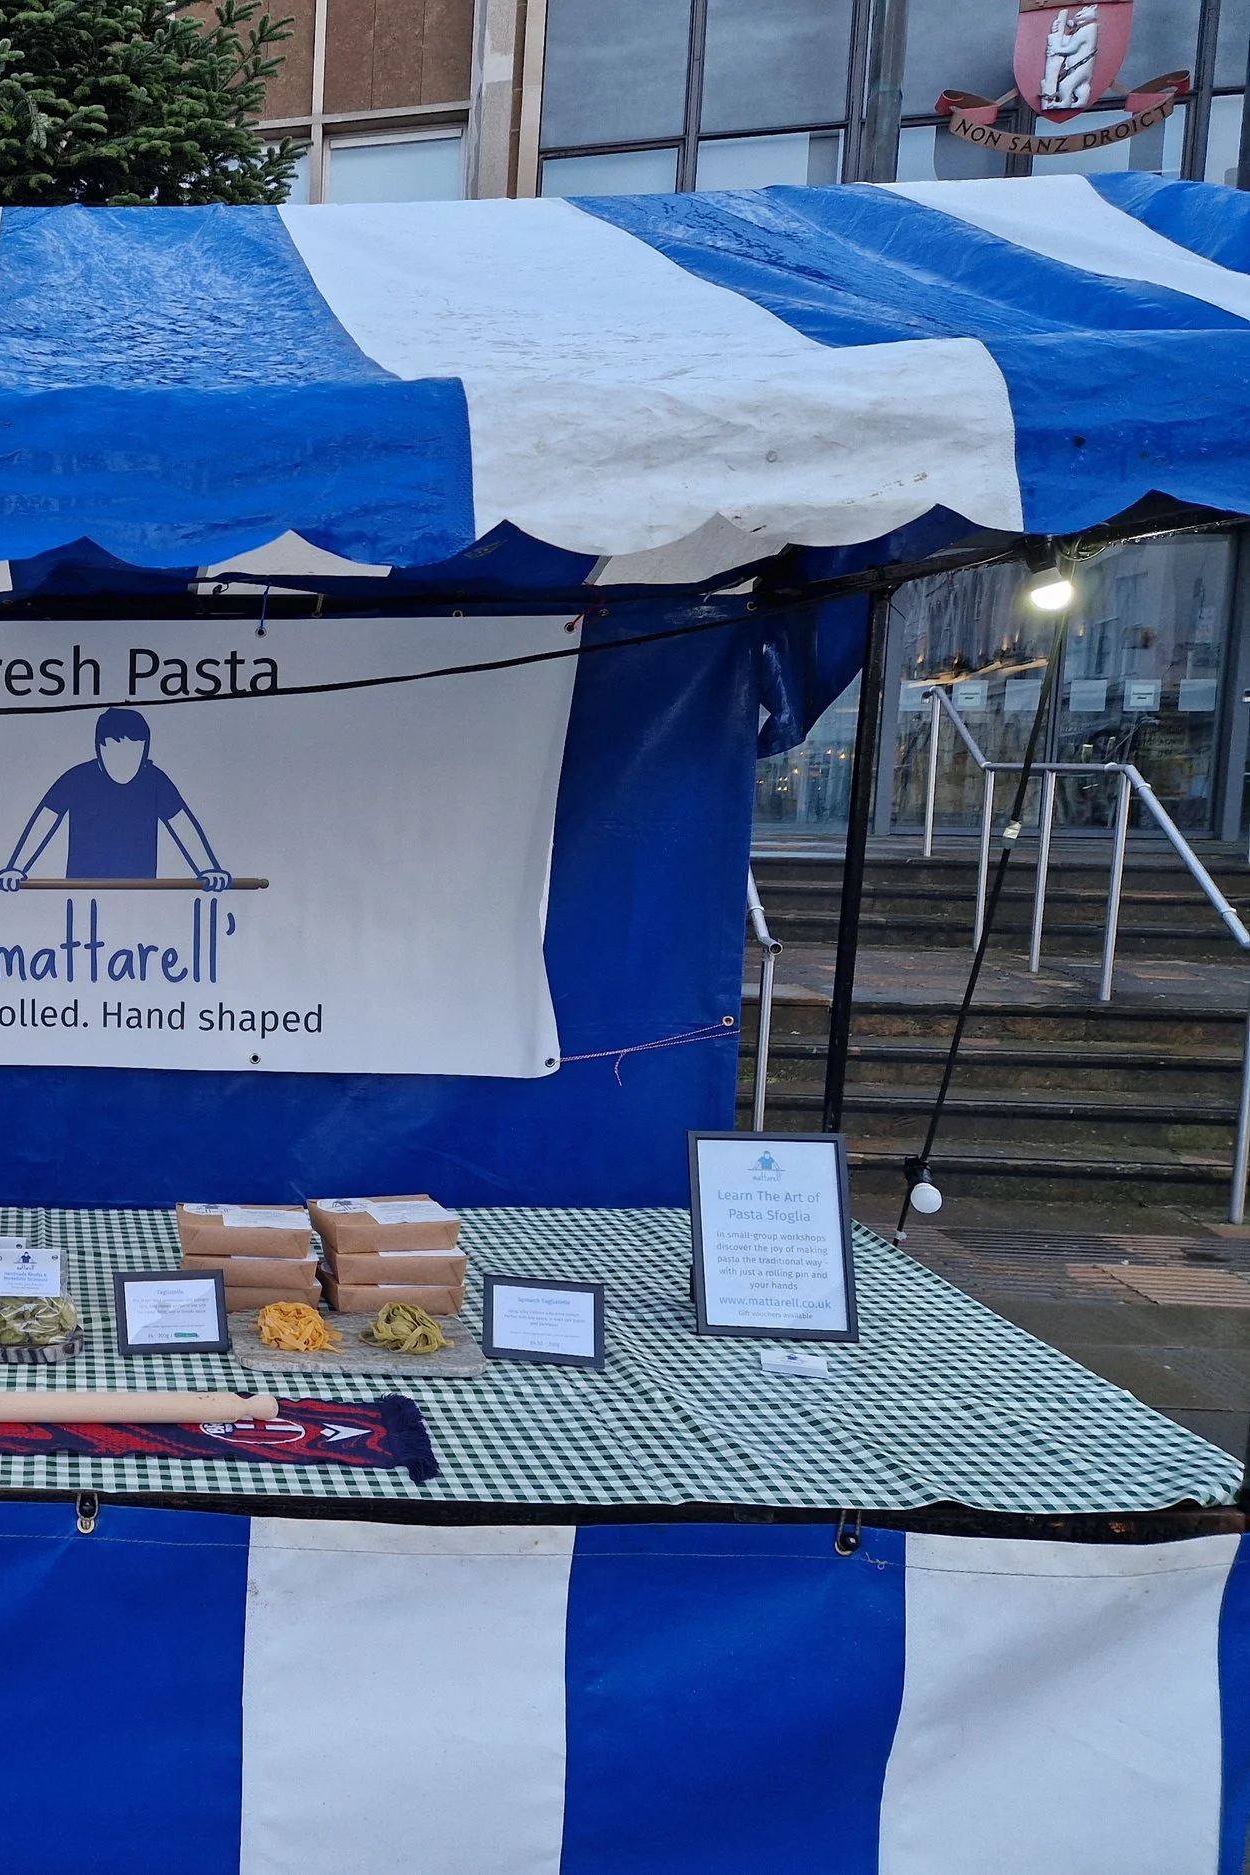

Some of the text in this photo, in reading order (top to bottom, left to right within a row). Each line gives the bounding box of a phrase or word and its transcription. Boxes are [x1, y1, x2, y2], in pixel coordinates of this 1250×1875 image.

[956, 102, 1170, 153] NON SANZ DROICT
[127, 649, 281, 698] Pasta
[102, 1002, 184, 1032] Hand
[198, 1004, 323, 1040] shaped
[718, 1190, 820, 1203] Learn The Art of
[729, 1208, 811, 1224] Pasta Sfoglia
[727, 1232, 778, 1241] small-group
[780, 1233, 826, 1242] workshops
[716, 1243, 752, 1251] discover
[786, 1244, 794, 1253] of
[797, 1246, 828, 1256] making
[718, 1256, 740, 1265] pasta
[758, 1256, 804, 1266] traditional
[805, 1259, 822, 1268] way
[719, 1267, 737, 1276] with
[739, 1268, 755, 1277] just
[765, 1268, 793, 1280] rolling
[795, 1270, 809, 1280] pin
[811, 1271, 828, 1279] and
[750, 1281, 798, 1290] your hands
[719, 1296, 831, 1309] www.mattarell.co.uk
